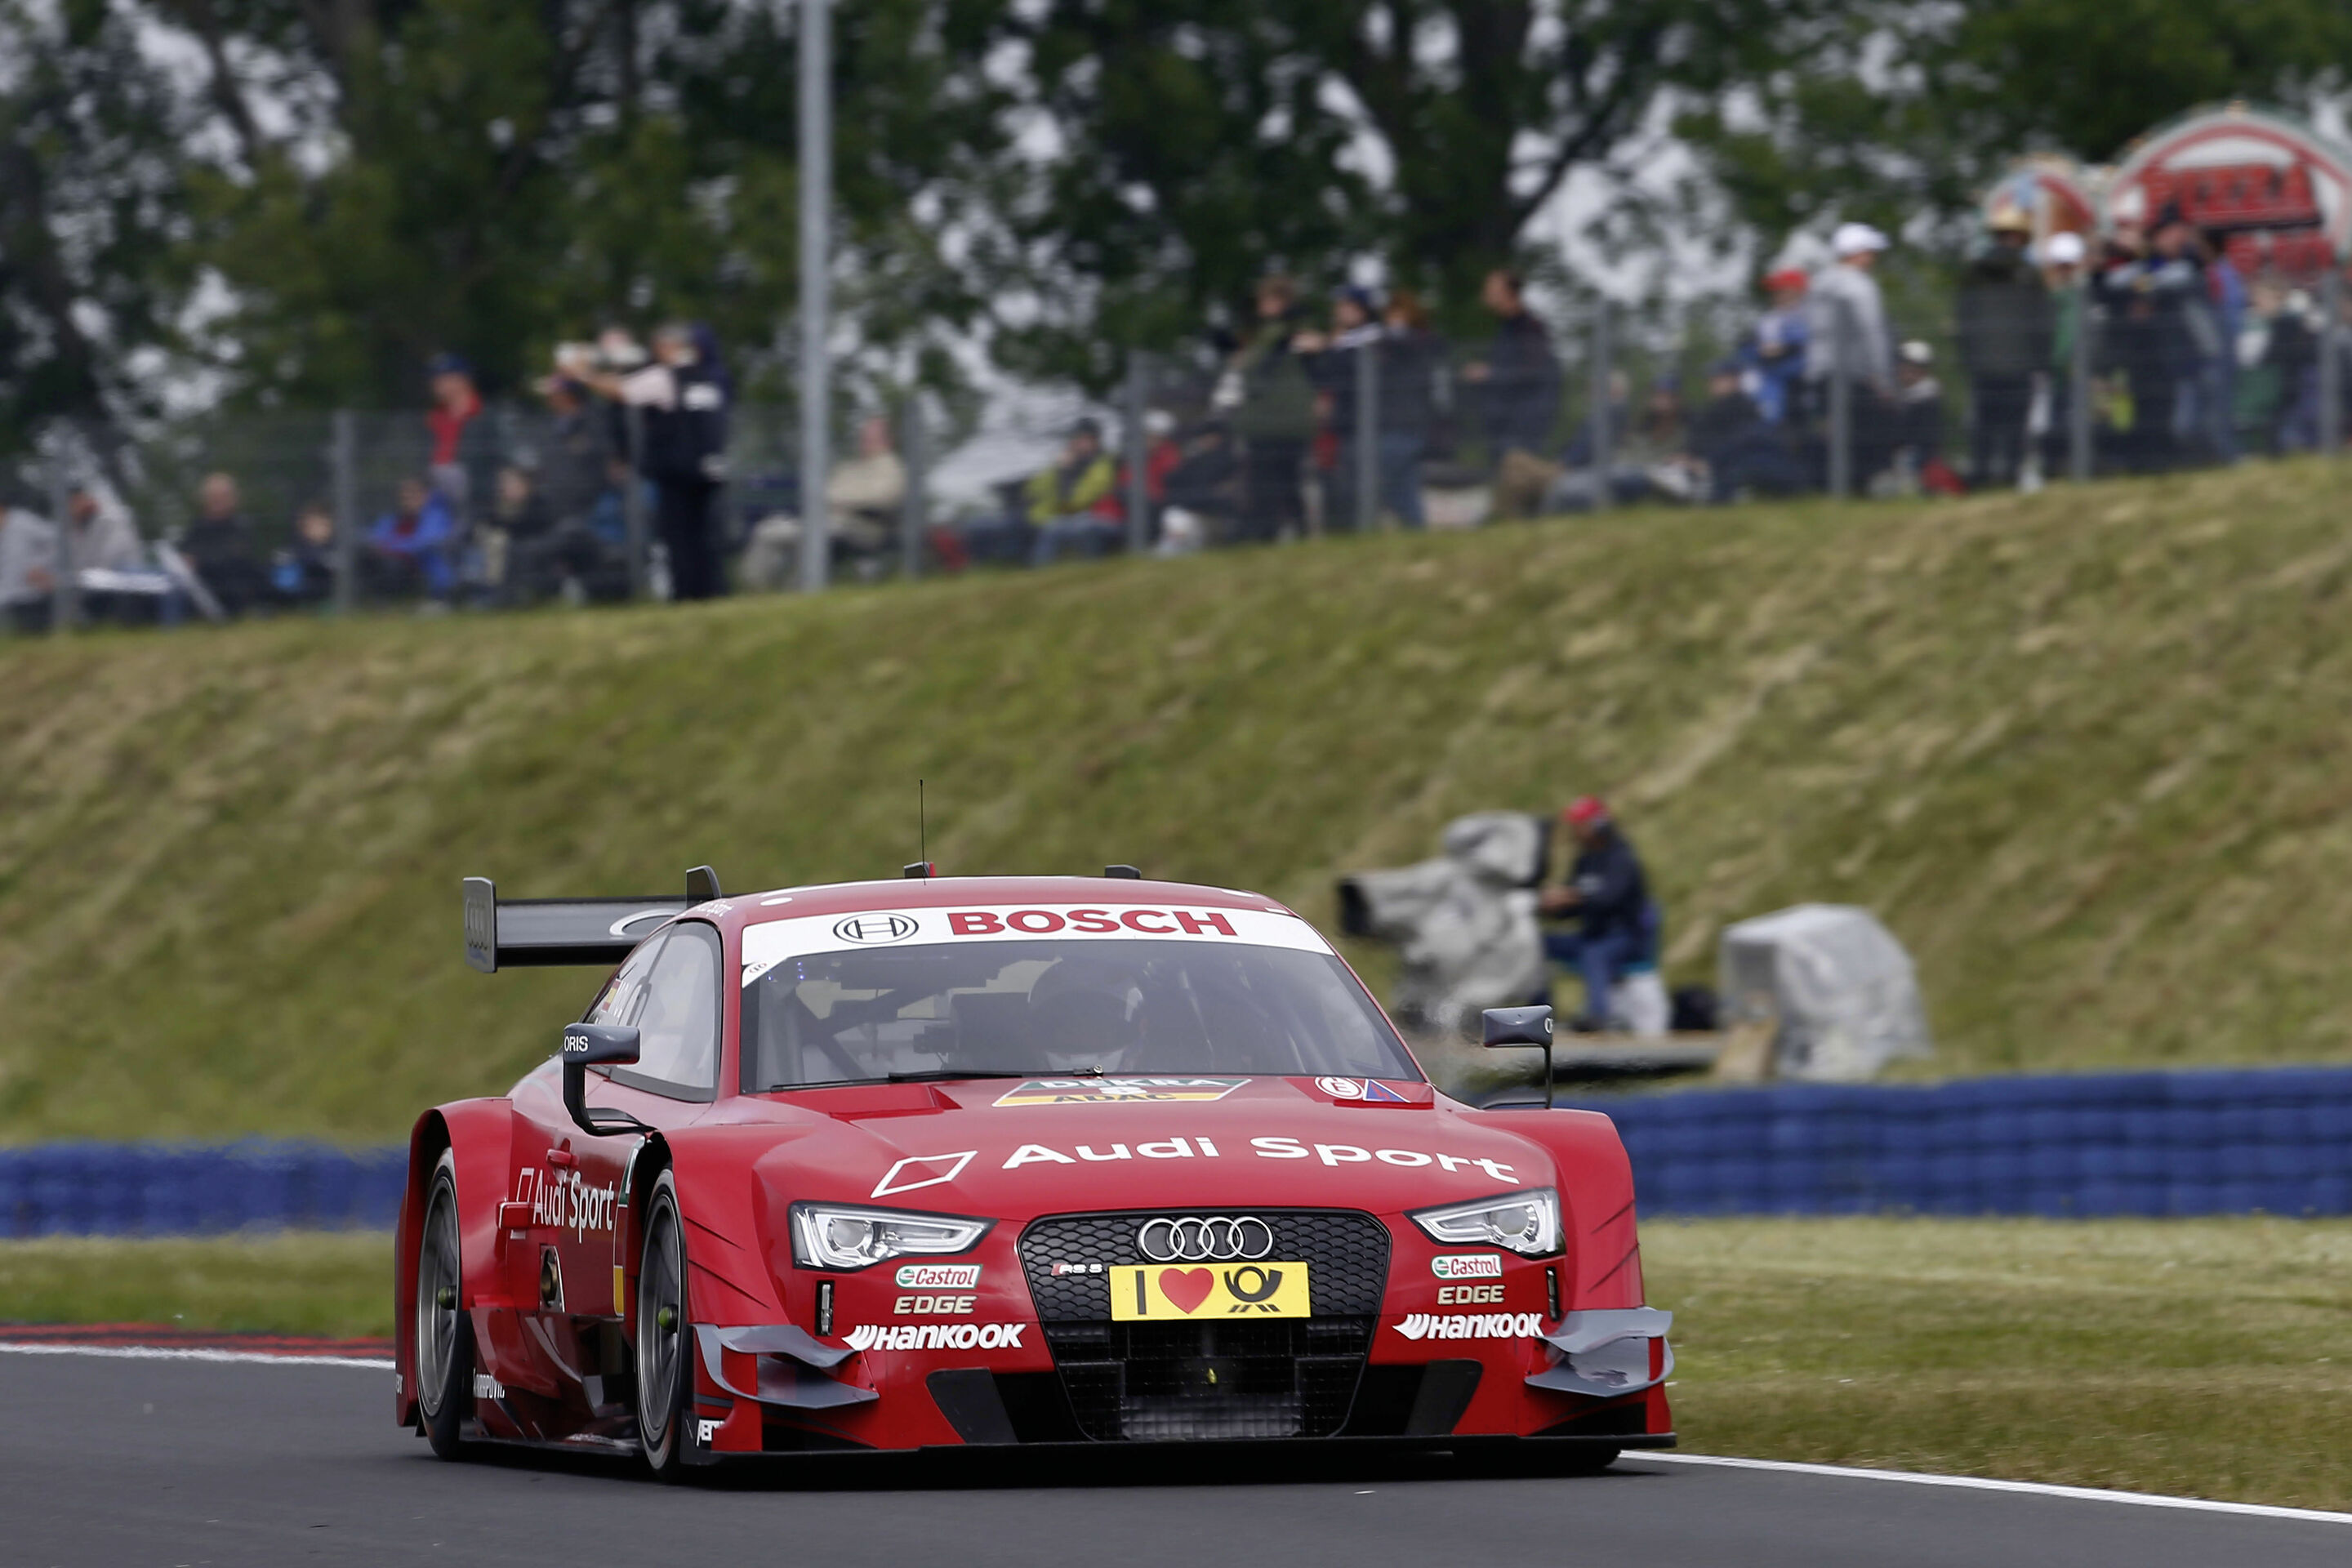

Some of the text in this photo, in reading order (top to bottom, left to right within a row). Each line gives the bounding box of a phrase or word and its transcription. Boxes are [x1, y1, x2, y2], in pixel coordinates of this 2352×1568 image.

[947, 909, 1239, 937] BOSCH
[564, 1036, 588, 1052] ORIS
[1040, 1079, 1228, 1088] DEKRA
[1054, 1094, 1176, 1102] ADAC
[1001, 1137, 1520, 1185] Audi Sport
[533, 1169, 567, 1227] Audi
[568, 1170, 614, 1244] Sport
[915, 1267, 974, 1285] Castrol
[1450, 1258, 1500, 1276] Castrol
[1135, 1270, 1147, 1316] I
[1437, 1285, 1506, 1305] EDGE
[893, 1295, 978, 1315] EDGE
